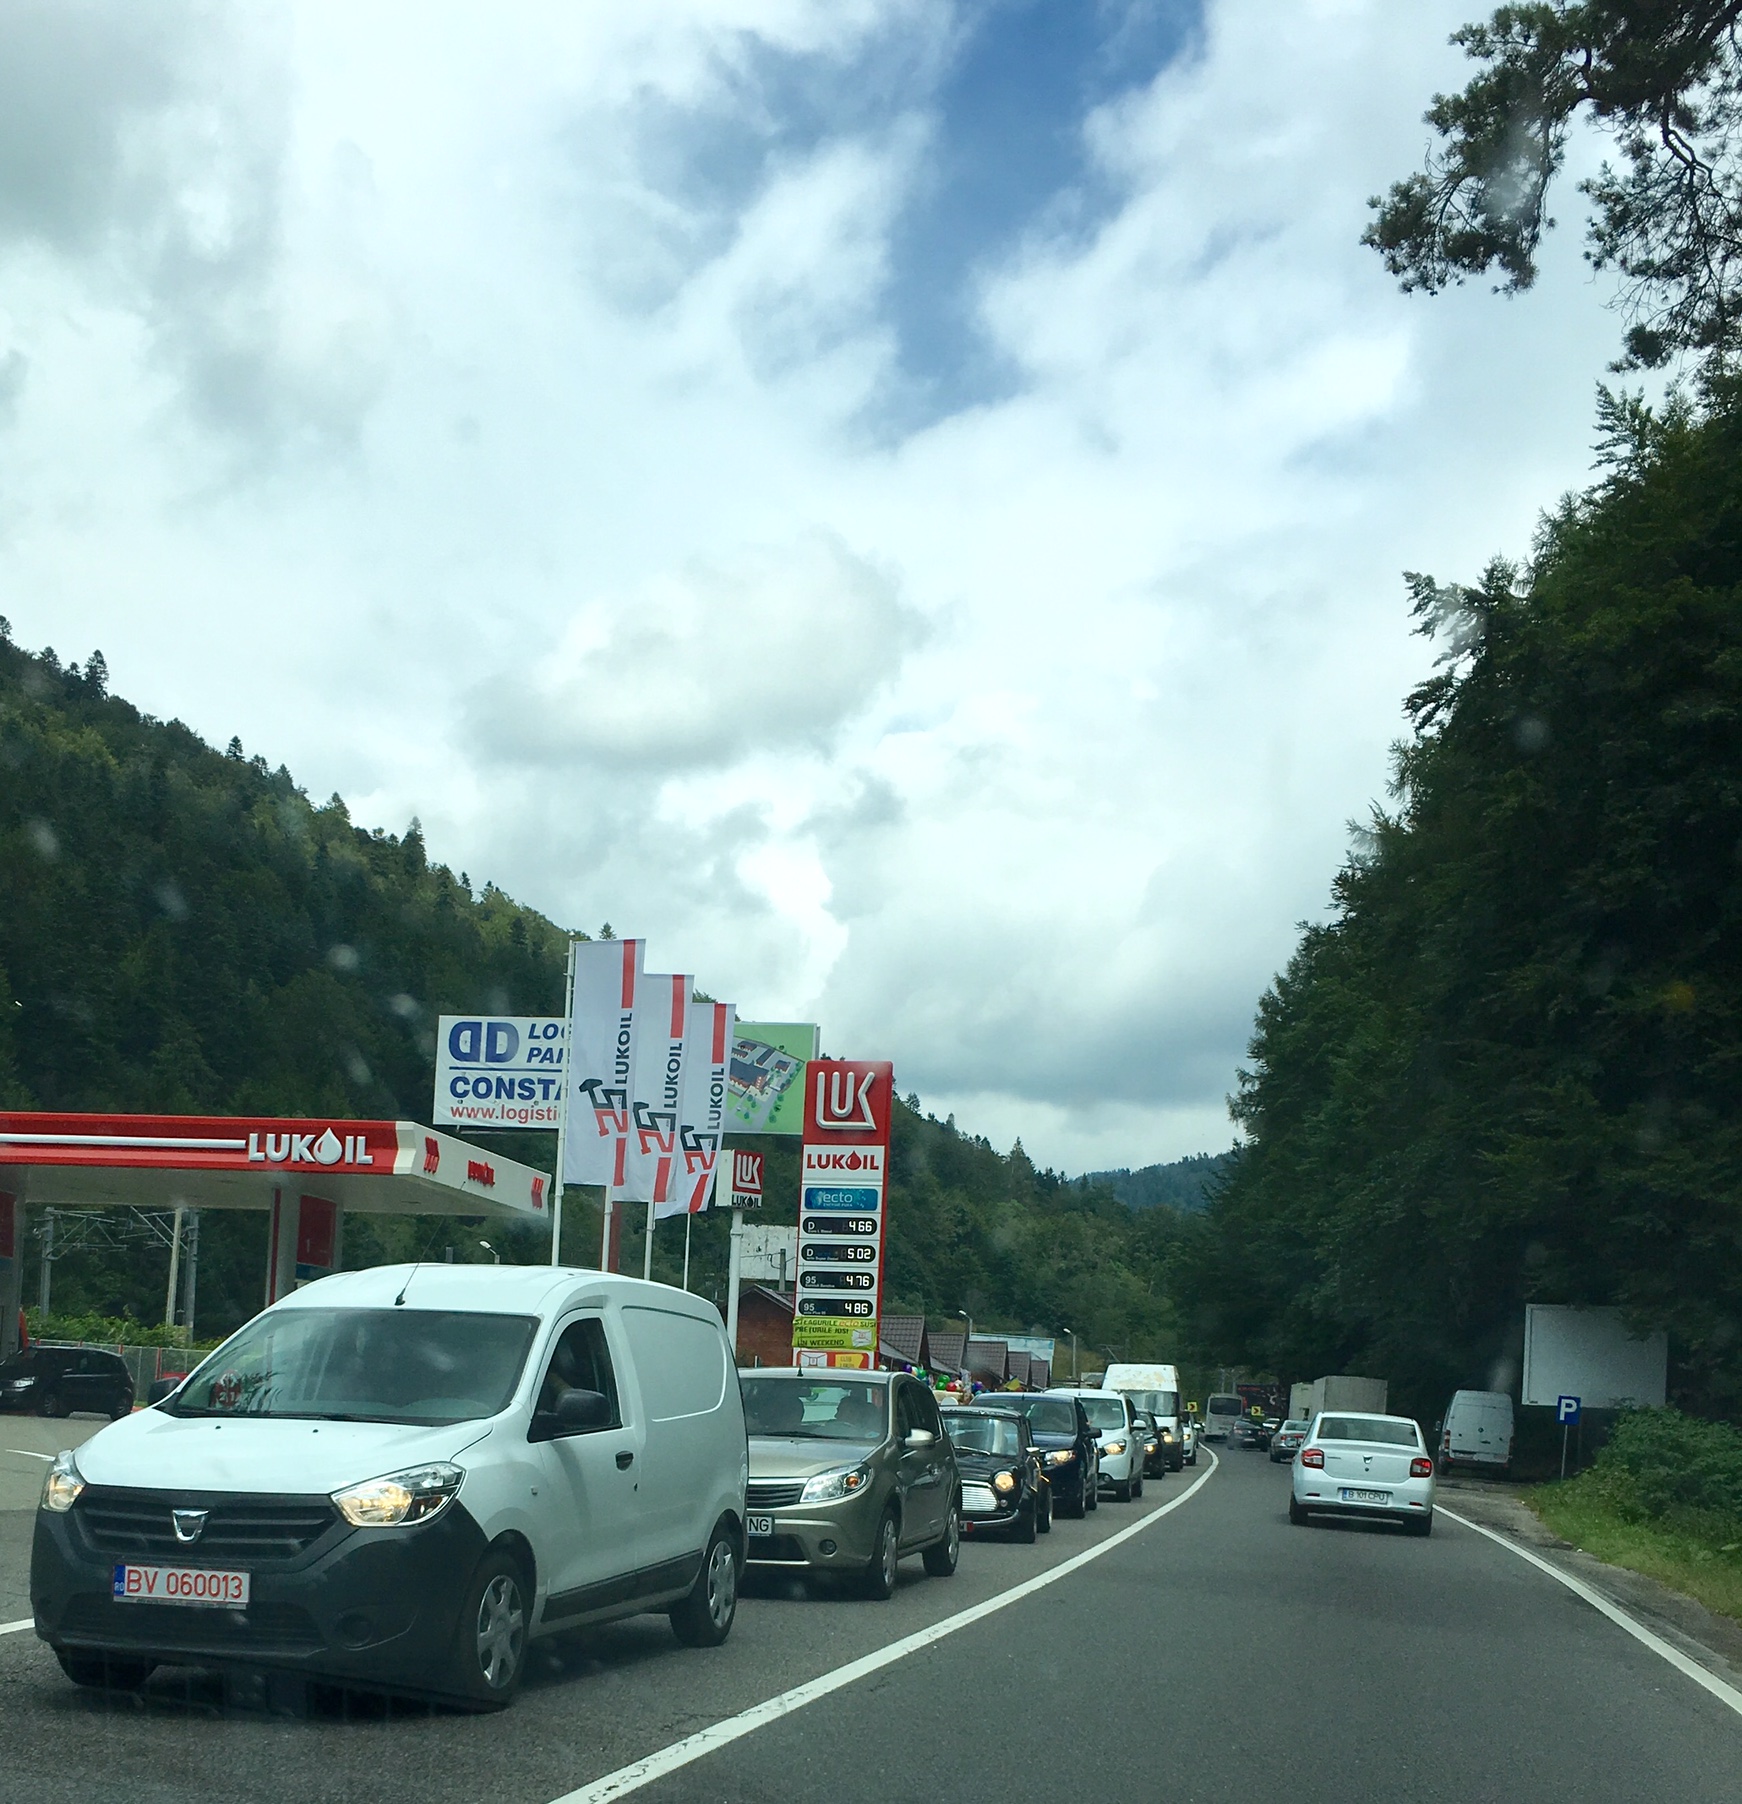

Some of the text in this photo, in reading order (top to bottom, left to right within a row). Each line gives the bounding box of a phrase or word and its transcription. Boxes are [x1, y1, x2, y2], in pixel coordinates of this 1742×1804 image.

[528, 1023, 565, 1039] LO
[615, 1013, 632, 1084] LUKOIL
[664, 1043, 682, 1108] LUKOIL
[707, 1067, 725, 1129] LUKOIL
[450, 1104, 561, 1124] www.logisti
[248, 1127, 374, 1165] LUKOIL
[806, 1150, 879, 1171] LUKOIL
[807, 1221, 816, 1230] D
[806, 1248, 814, 1257] D
[805, 1275, 817, 1284] 95
[803, 1303, 815, 1312] 95
[1559, 1398, 1577, 1421] P
[126, 1569, 243, 1599] BV 060013
